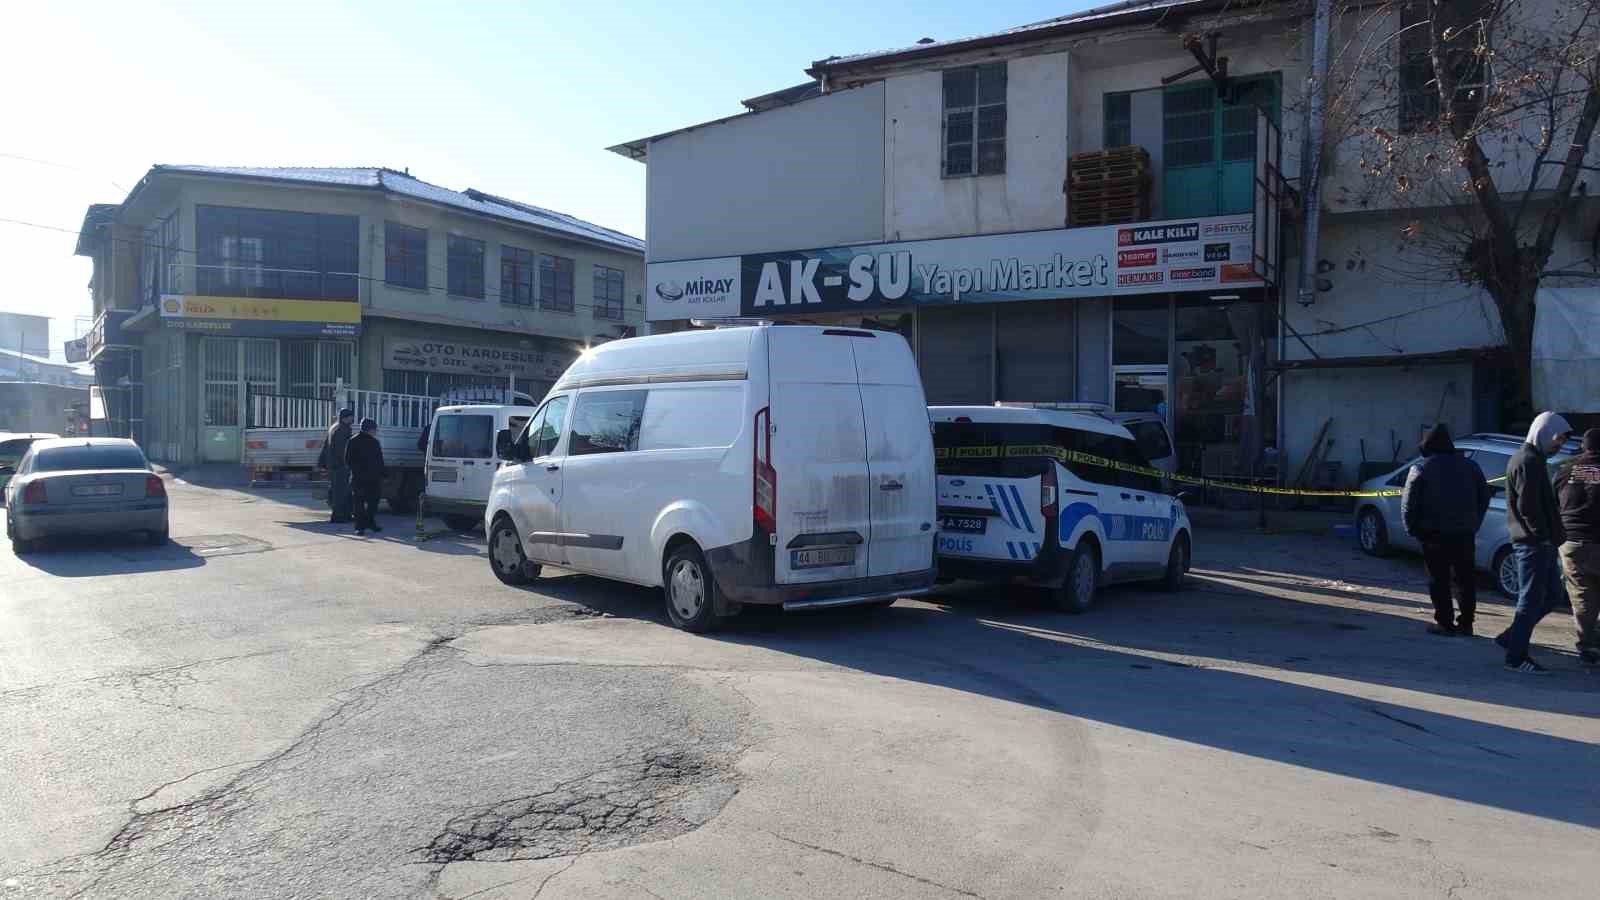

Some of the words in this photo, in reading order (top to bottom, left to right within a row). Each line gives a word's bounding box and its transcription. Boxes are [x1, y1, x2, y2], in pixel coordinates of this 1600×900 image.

[1134, 228, 1164, 241] KALE
[753, 250, 912, 307] AK-SU
[918, 263, 984, 301] Yapı
[989, 253, 1108, 292] Market
[685, 276, 735, 296] MİRAY
[422, 343, 456, 356] OTO
[958, 519, 982, 529] 7528
